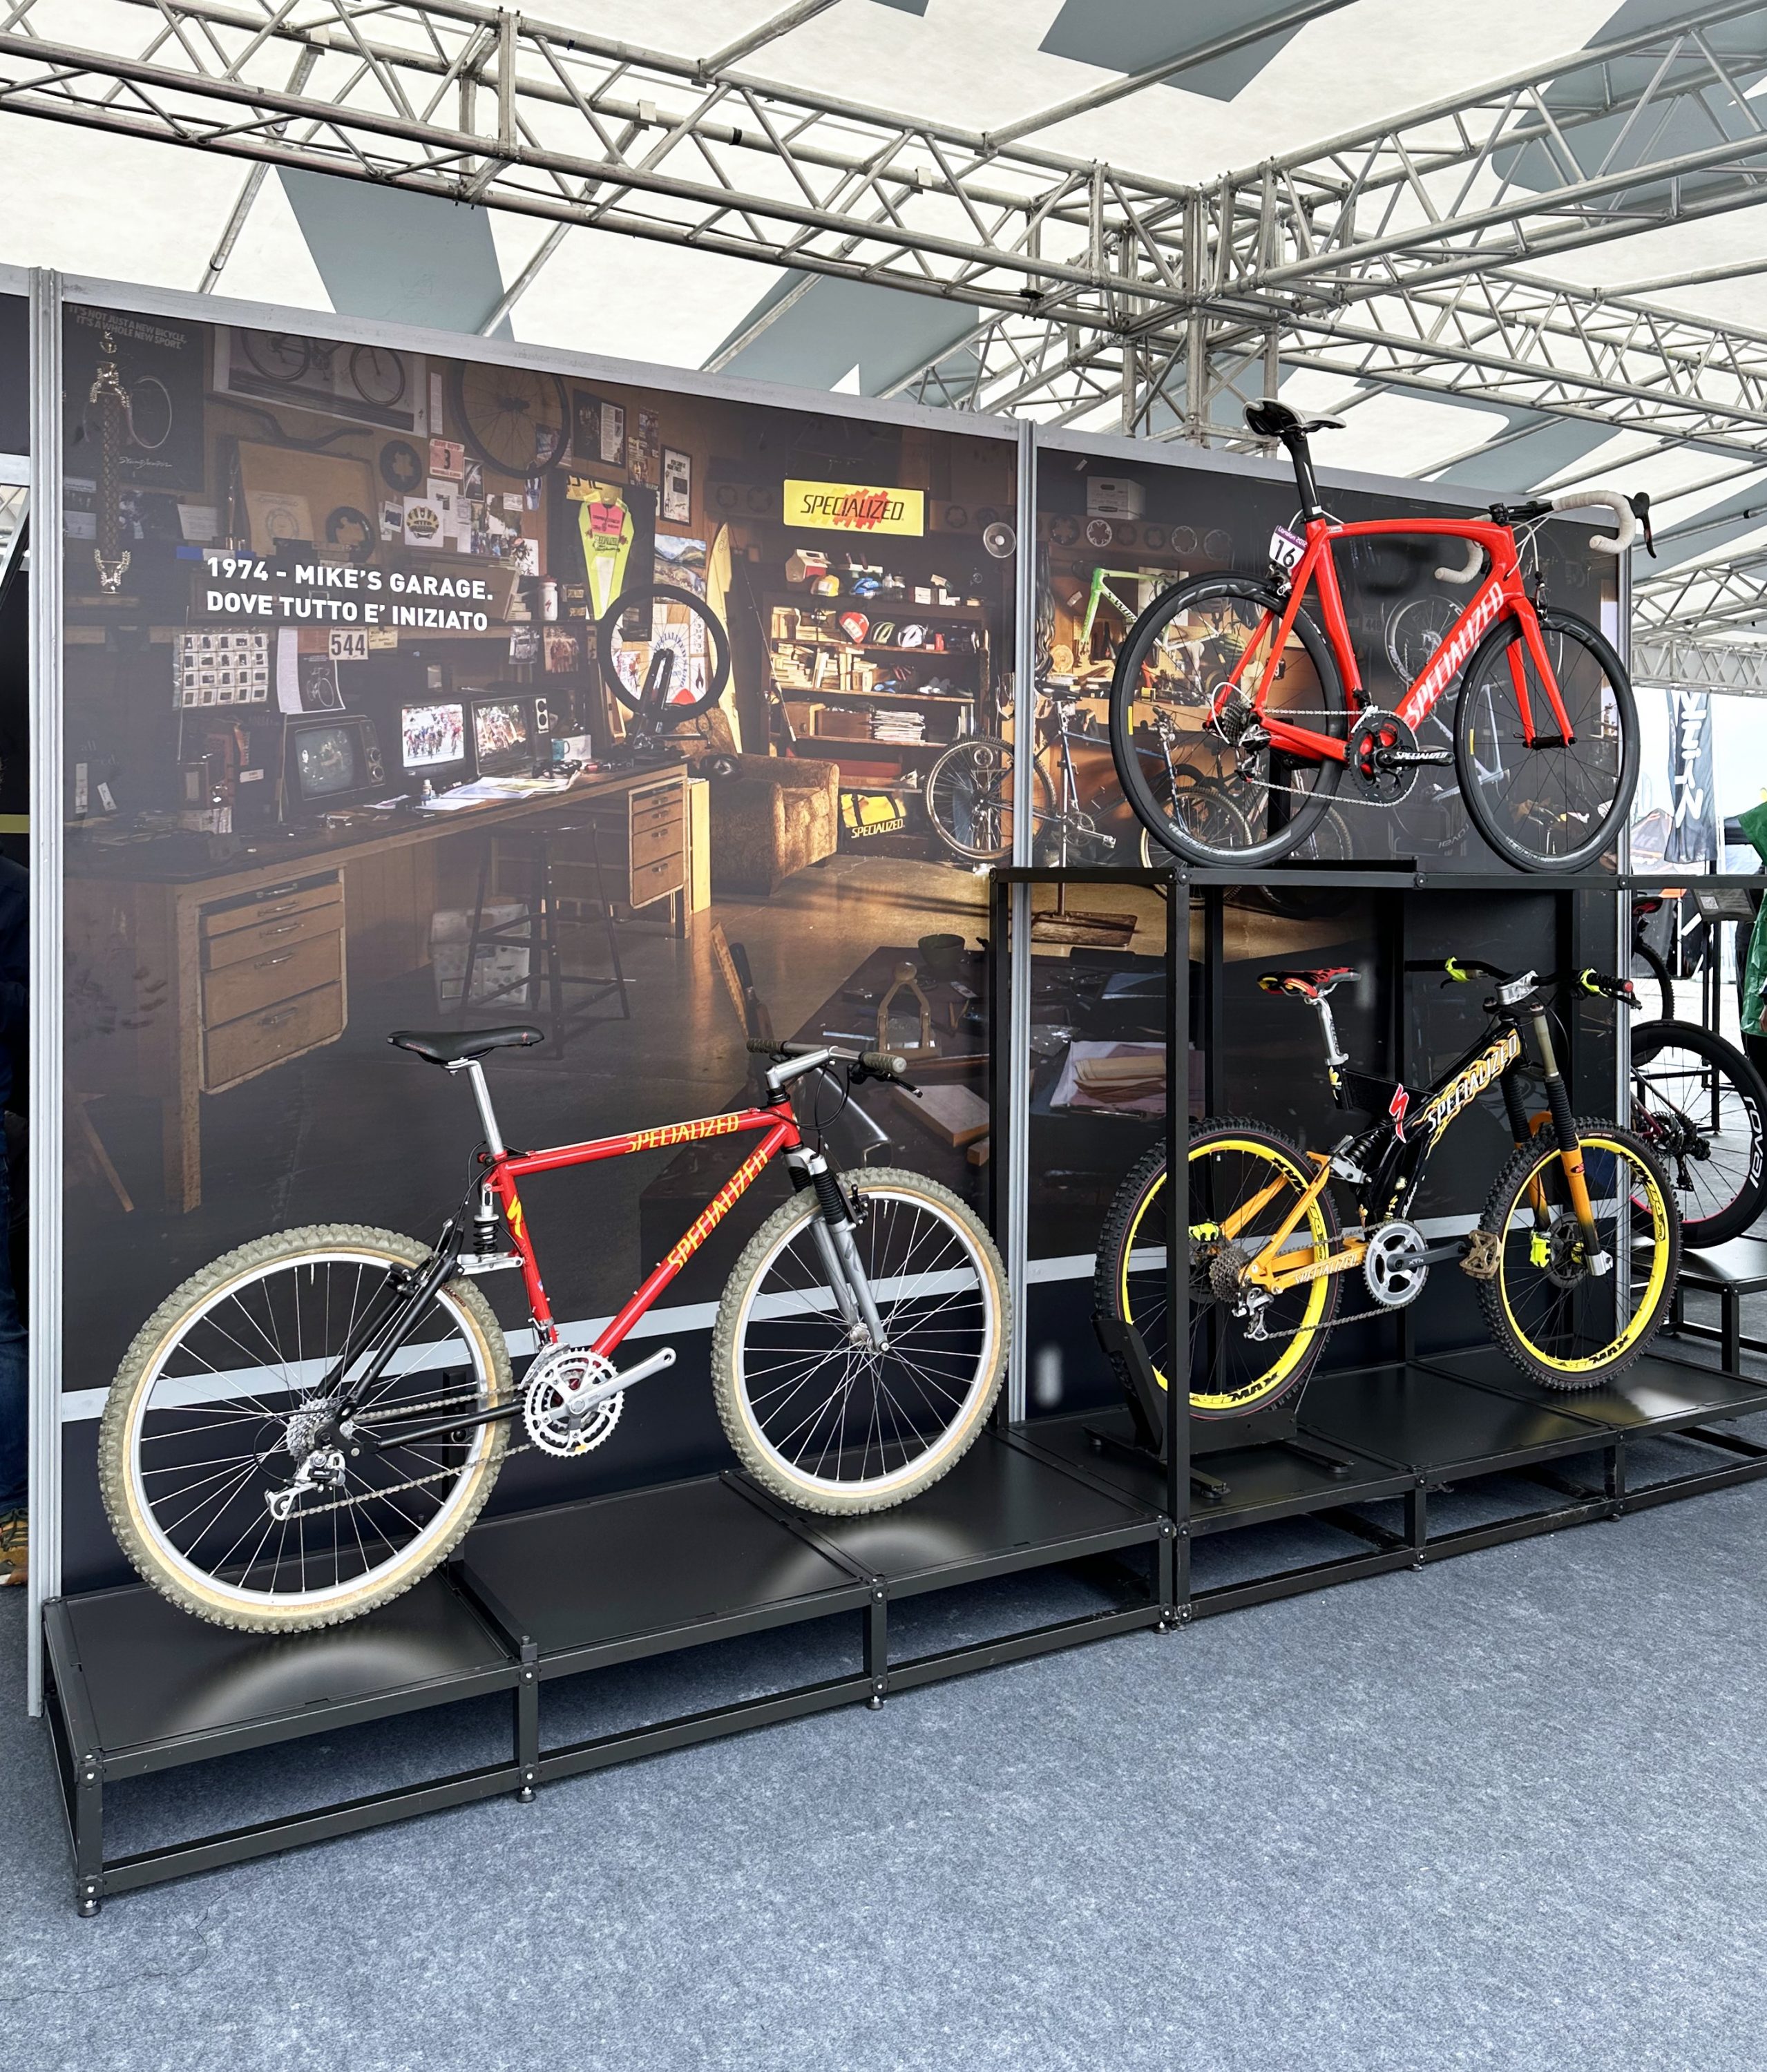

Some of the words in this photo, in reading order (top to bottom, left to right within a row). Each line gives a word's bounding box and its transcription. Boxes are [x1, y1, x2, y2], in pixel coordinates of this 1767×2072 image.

[88, 311, 107, 321] NOT
[108, 315, 128, 326] JUST
[135, 322, 155, 334] NEW
[134, 330, 155, 343] NEW
[444, 449, 450, 470] 3
[801, 494, 905, 521] SPECIALIZED
[1274, 539, 1296, 568] 16
[207, 557, 269, 582] 1974
[295, 564, 382, 591] MIKE'S
[390, 573, 493, 601] GARAGE.
[207, 591, 273, 615] DOVE
[278, 595, 358, 622] TUTTO
[364, 603, 385, 623] E'
[392, 606, 488, 631] INIZIATO
[331, 634, 365, 656] 544
[1403, 580, 1505, 730] SPECIALIZED
[1394, 751, 1449, 760] SPECIALIZED
[850, 818, 904, 838] SPECIALIZED
[1428, 1033, 1518, 1133] SPECIALIZED
[624, 1115, 739, 1154] SPECIALIZED
[1743, 1095, 1764, 1189] roval
[667, 1149, 768, 1275] SPECIALIZED
